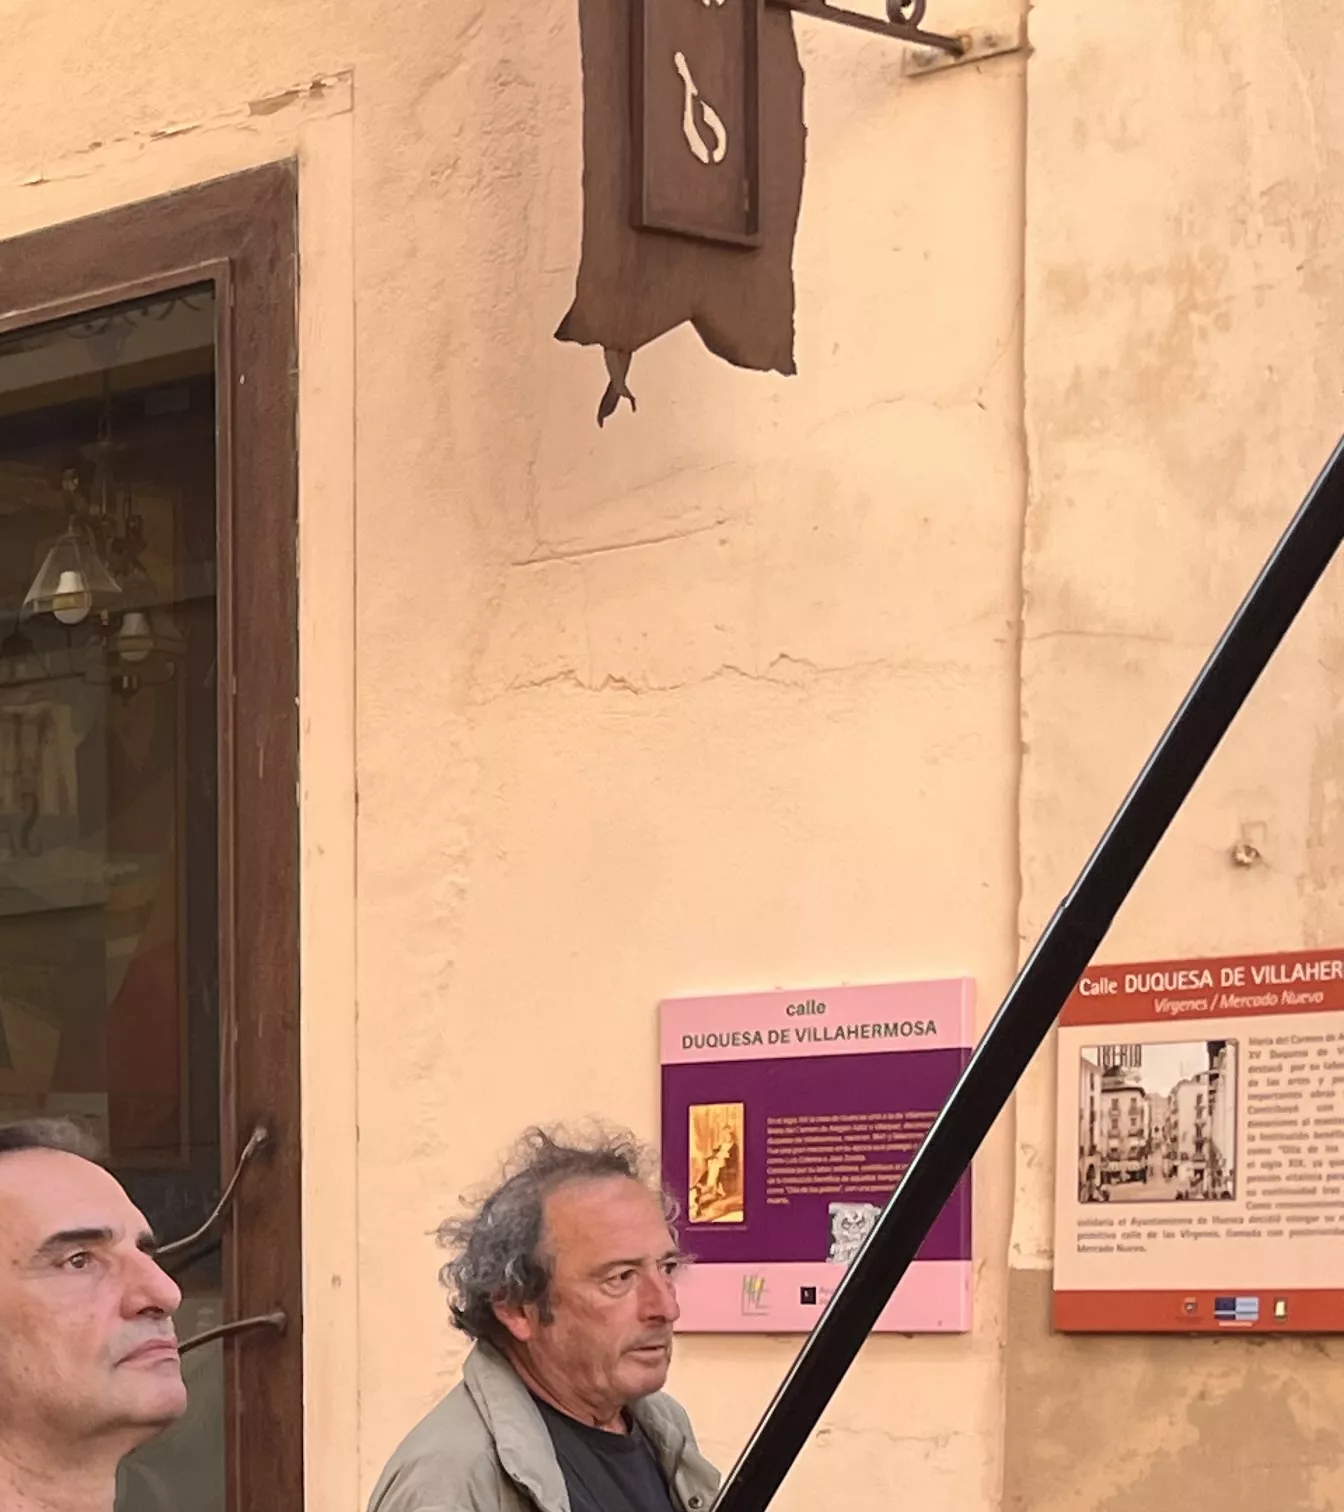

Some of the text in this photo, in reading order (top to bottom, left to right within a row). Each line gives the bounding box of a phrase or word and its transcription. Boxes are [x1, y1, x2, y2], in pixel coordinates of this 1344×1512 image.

[1078, 977, 1118, 996] Calle
[1124, 968, 1214, 993] DUQUESA
[1220, 967, 1245, 987] DE
[785, 1000, 826, 1017] calle
[1220, 990, 1278, 1009] Mercado
[1281, 989, 1324, 1006] Nuevo
[682, 1019, 938, 1050] DUQUESA DE VILLAHERMOSA
